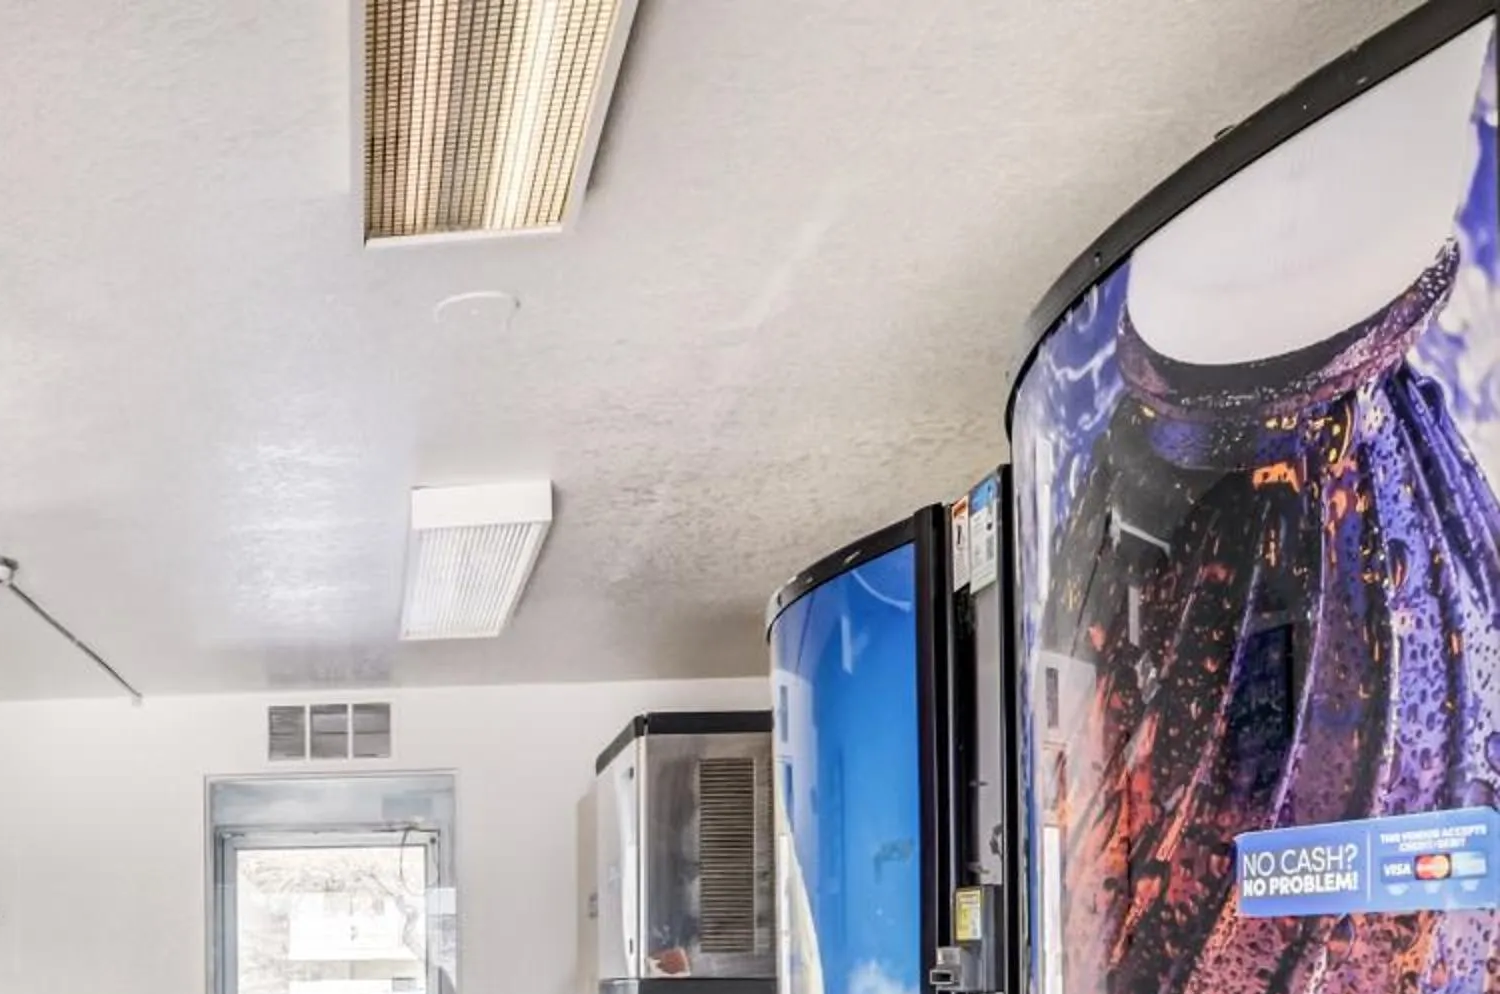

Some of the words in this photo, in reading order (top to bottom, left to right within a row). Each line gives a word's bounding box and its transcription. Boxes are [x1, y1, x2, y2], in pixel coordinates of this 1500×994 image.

[1243, 851, 1275, 877] NO
[1281, 843, 1359, 875] CASH?
[1383, 863, 1412, 876] VISA
[1243, 878, 1266, 896] NO
[1269, 872, 1358, 895] PROBLEM!
